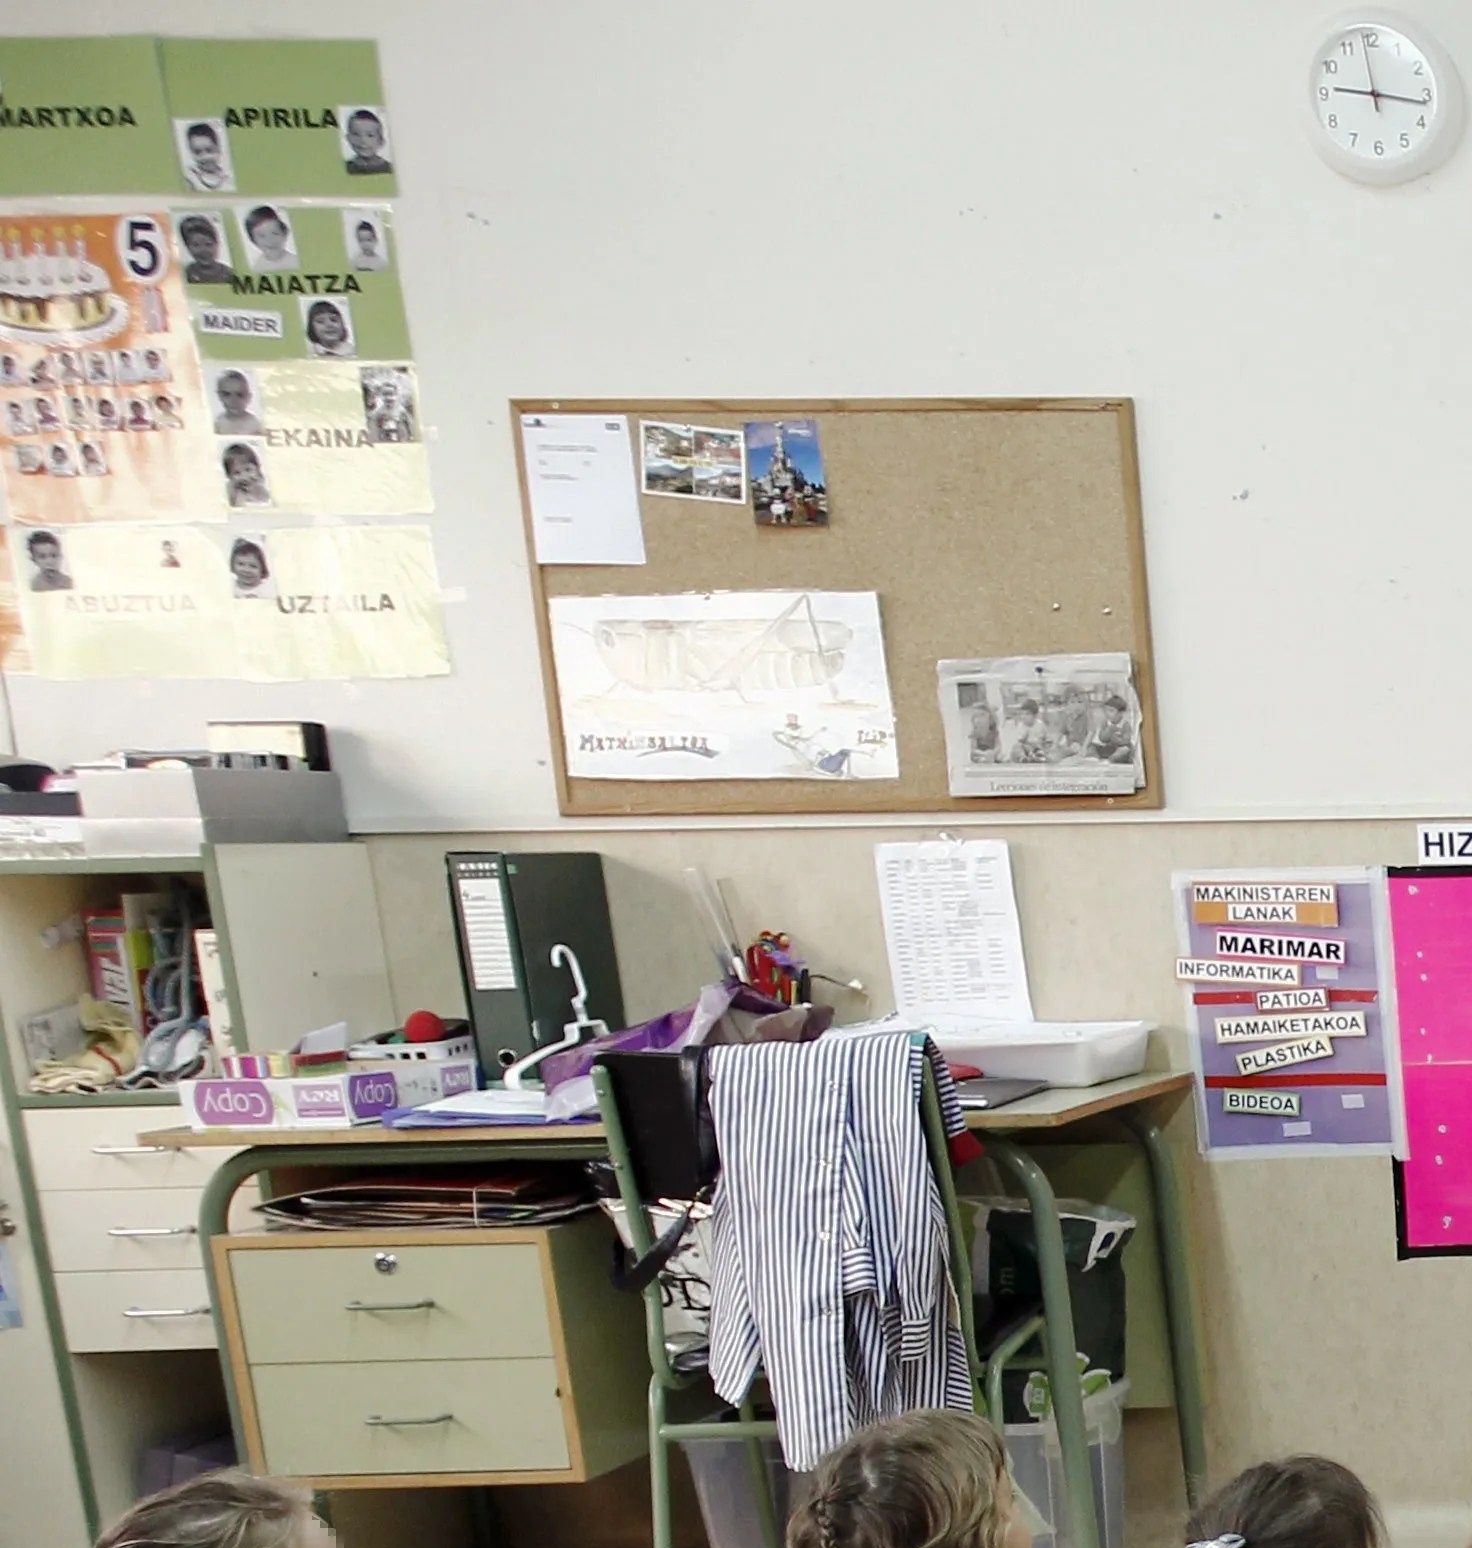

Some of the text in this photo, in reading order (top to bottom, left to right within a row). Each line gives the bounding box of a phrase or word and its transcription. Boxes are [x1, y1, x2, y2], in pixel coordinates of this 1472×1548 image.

[1363, 32, 1380, 48] 12
[1341, 42, 1354, 56] 11
[1394, 43, 1401, 56] 1
[1322, 60, 1338, 74] 10
[1413, 61, 1424, 76] 2
[1319, 86, 1329, 101] 9
[1421, 88, 1432, 103] 3
[0, 106, 137, 129] MARTXOA
[224, 106, 339, 130] APIRILA
[1328, 114, 1338, 128] 8
[1416, 115, 1426, 129] 4
[1349, 133, 1358, 147] 7
[1374, 141, 1384, 155] 6
[1400, 133, 1410, 148] 5
[127, 221, 160, 278] 5
[232, 273, 363, 297] MAIATZA
[203, 314, 278, 334] MAIDER
[266, 427, 377, 450] EKAINA
[1195, 886, 1331, 902] MAKINISTAREN
[1232, 905, 1295, 921] LANAK
[1218, 935, 1342, 961] MARIMAR
[1178, 960, 1296, 982] INFORMATIKA
[1258, 990, 1325, 1009] PATIOA
[1219, 1015, 1362, 1037] HAMAIKETAKOA
[1240, 1039, 1329, 1072] PLASTIKA
[355, 1079, 395, 1108] Copy
[1228, 1093, 1296, 1111] BIDEOA
[202, 1087, 268, 1118] Copy
